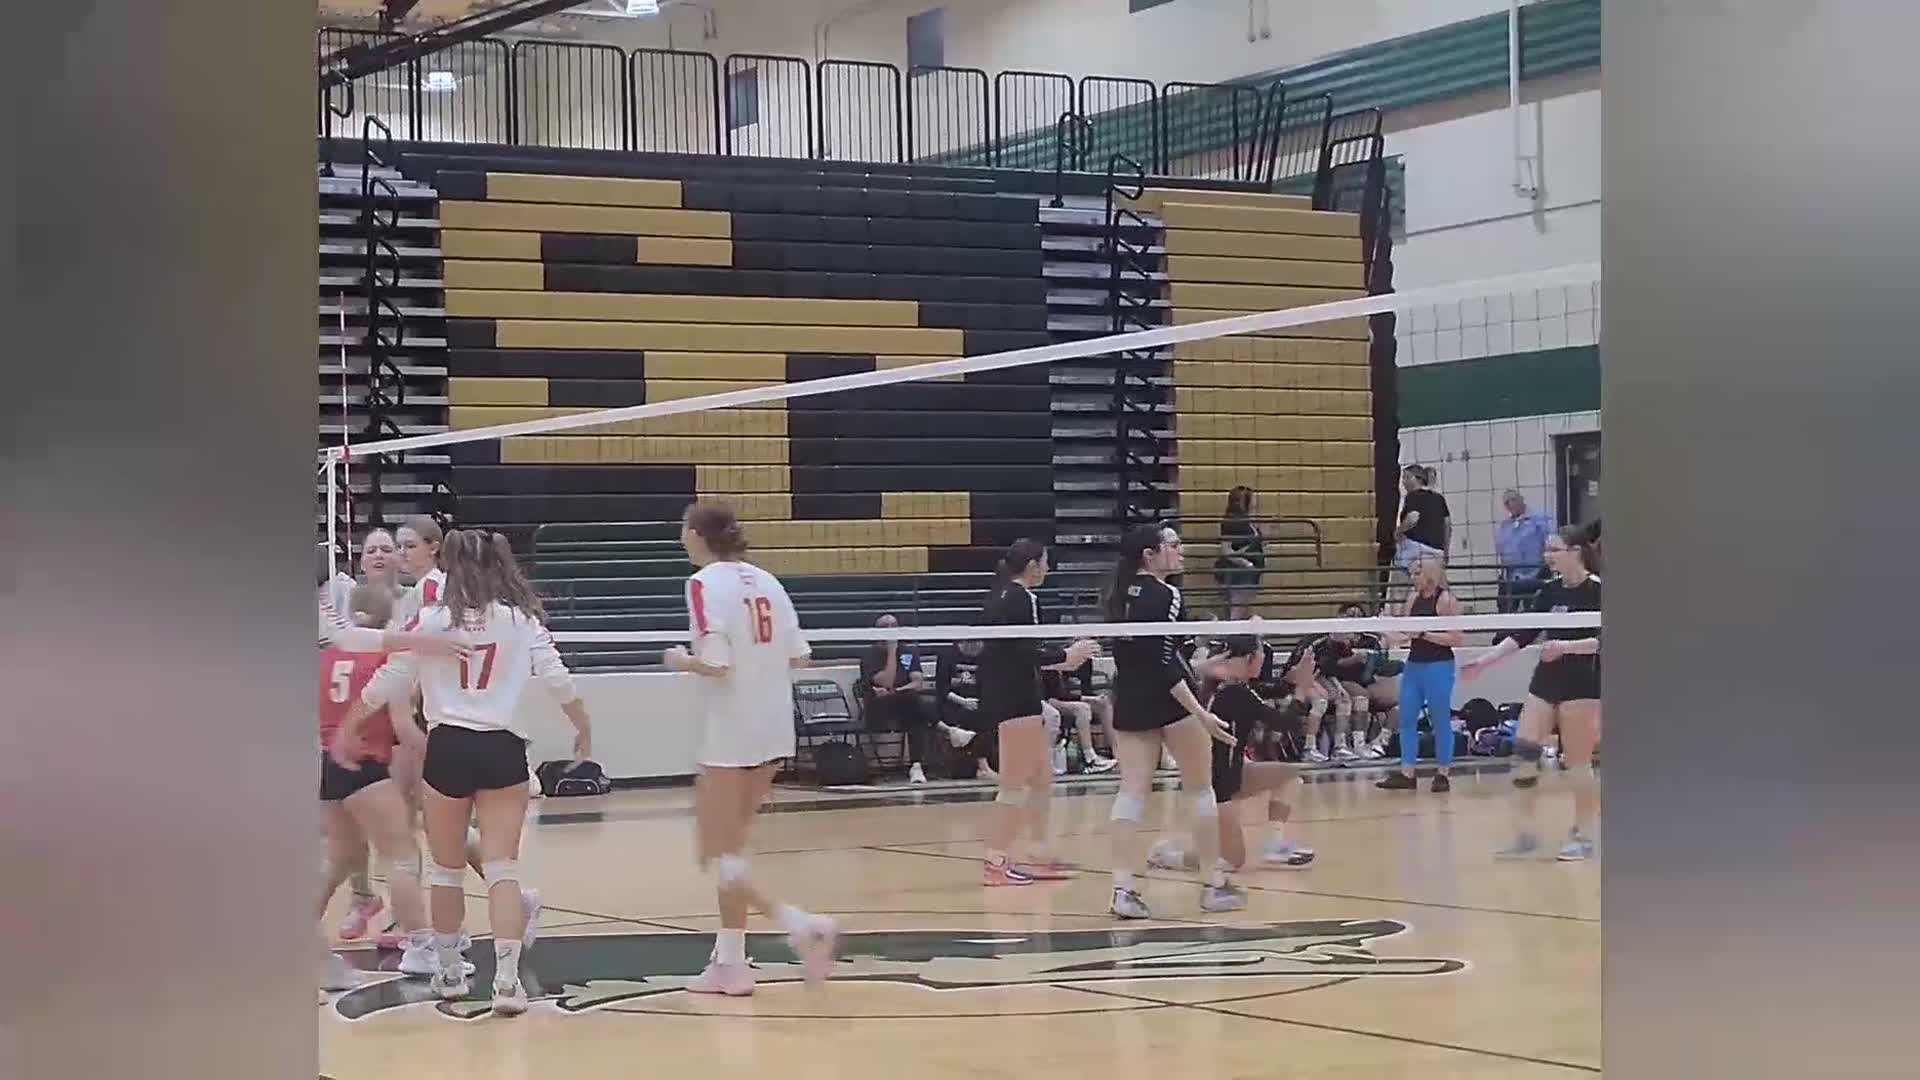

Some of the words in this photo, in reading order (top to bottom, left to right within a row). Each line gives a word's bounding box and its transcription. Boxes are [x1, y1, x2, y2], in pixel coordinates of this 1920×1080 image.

[743, 596, 772, 645] 16
[328, 660, 355, 703] 5
[459, 642, 497, 690] 17
